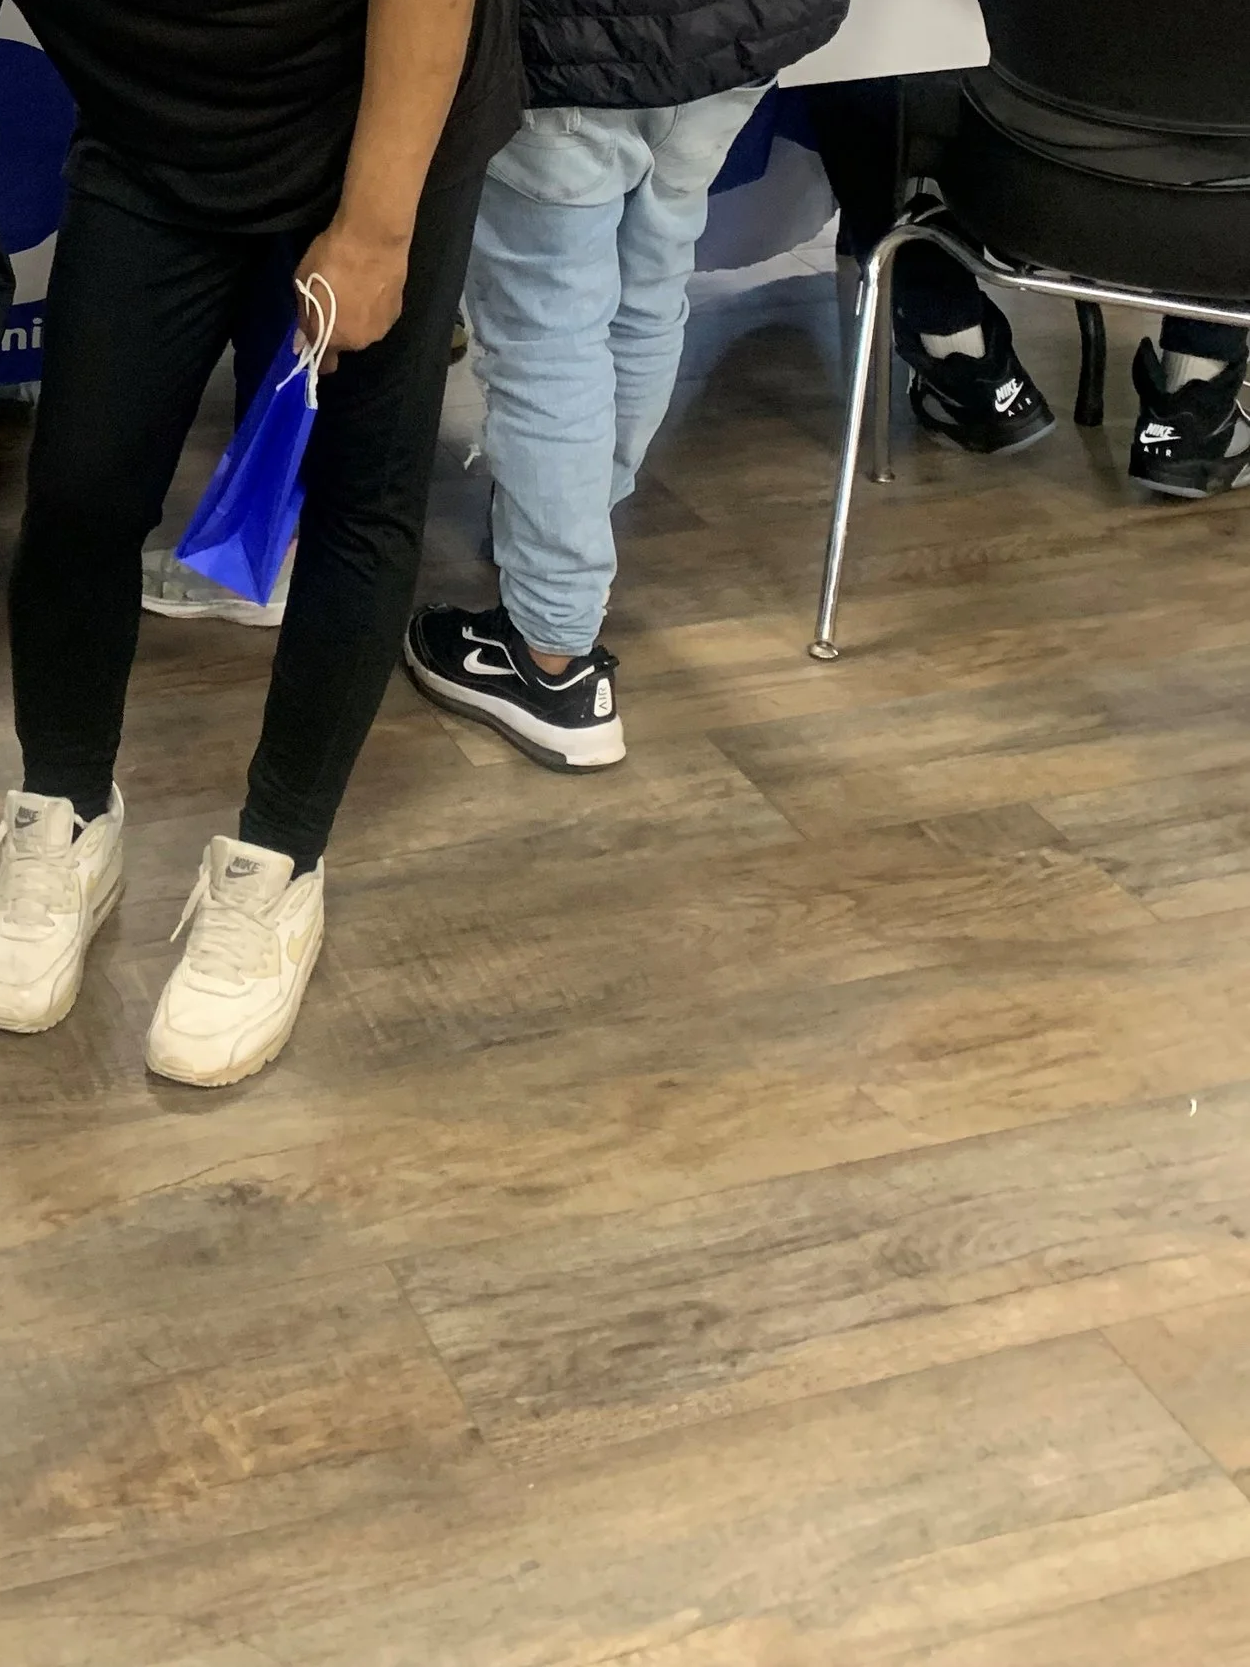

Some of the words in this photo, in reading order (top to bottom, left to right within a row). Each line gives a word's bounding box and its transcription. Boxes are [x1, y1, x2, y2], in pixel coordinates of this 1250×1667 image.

[995, 377, 1018, 403] NIKE
[1007, 397, 1032, 417] AIR
[1145, 422, 1175, 438] NIKE
[1143, 445, 1172, 458] AIR
[597, 687, 608, 711] AIR
